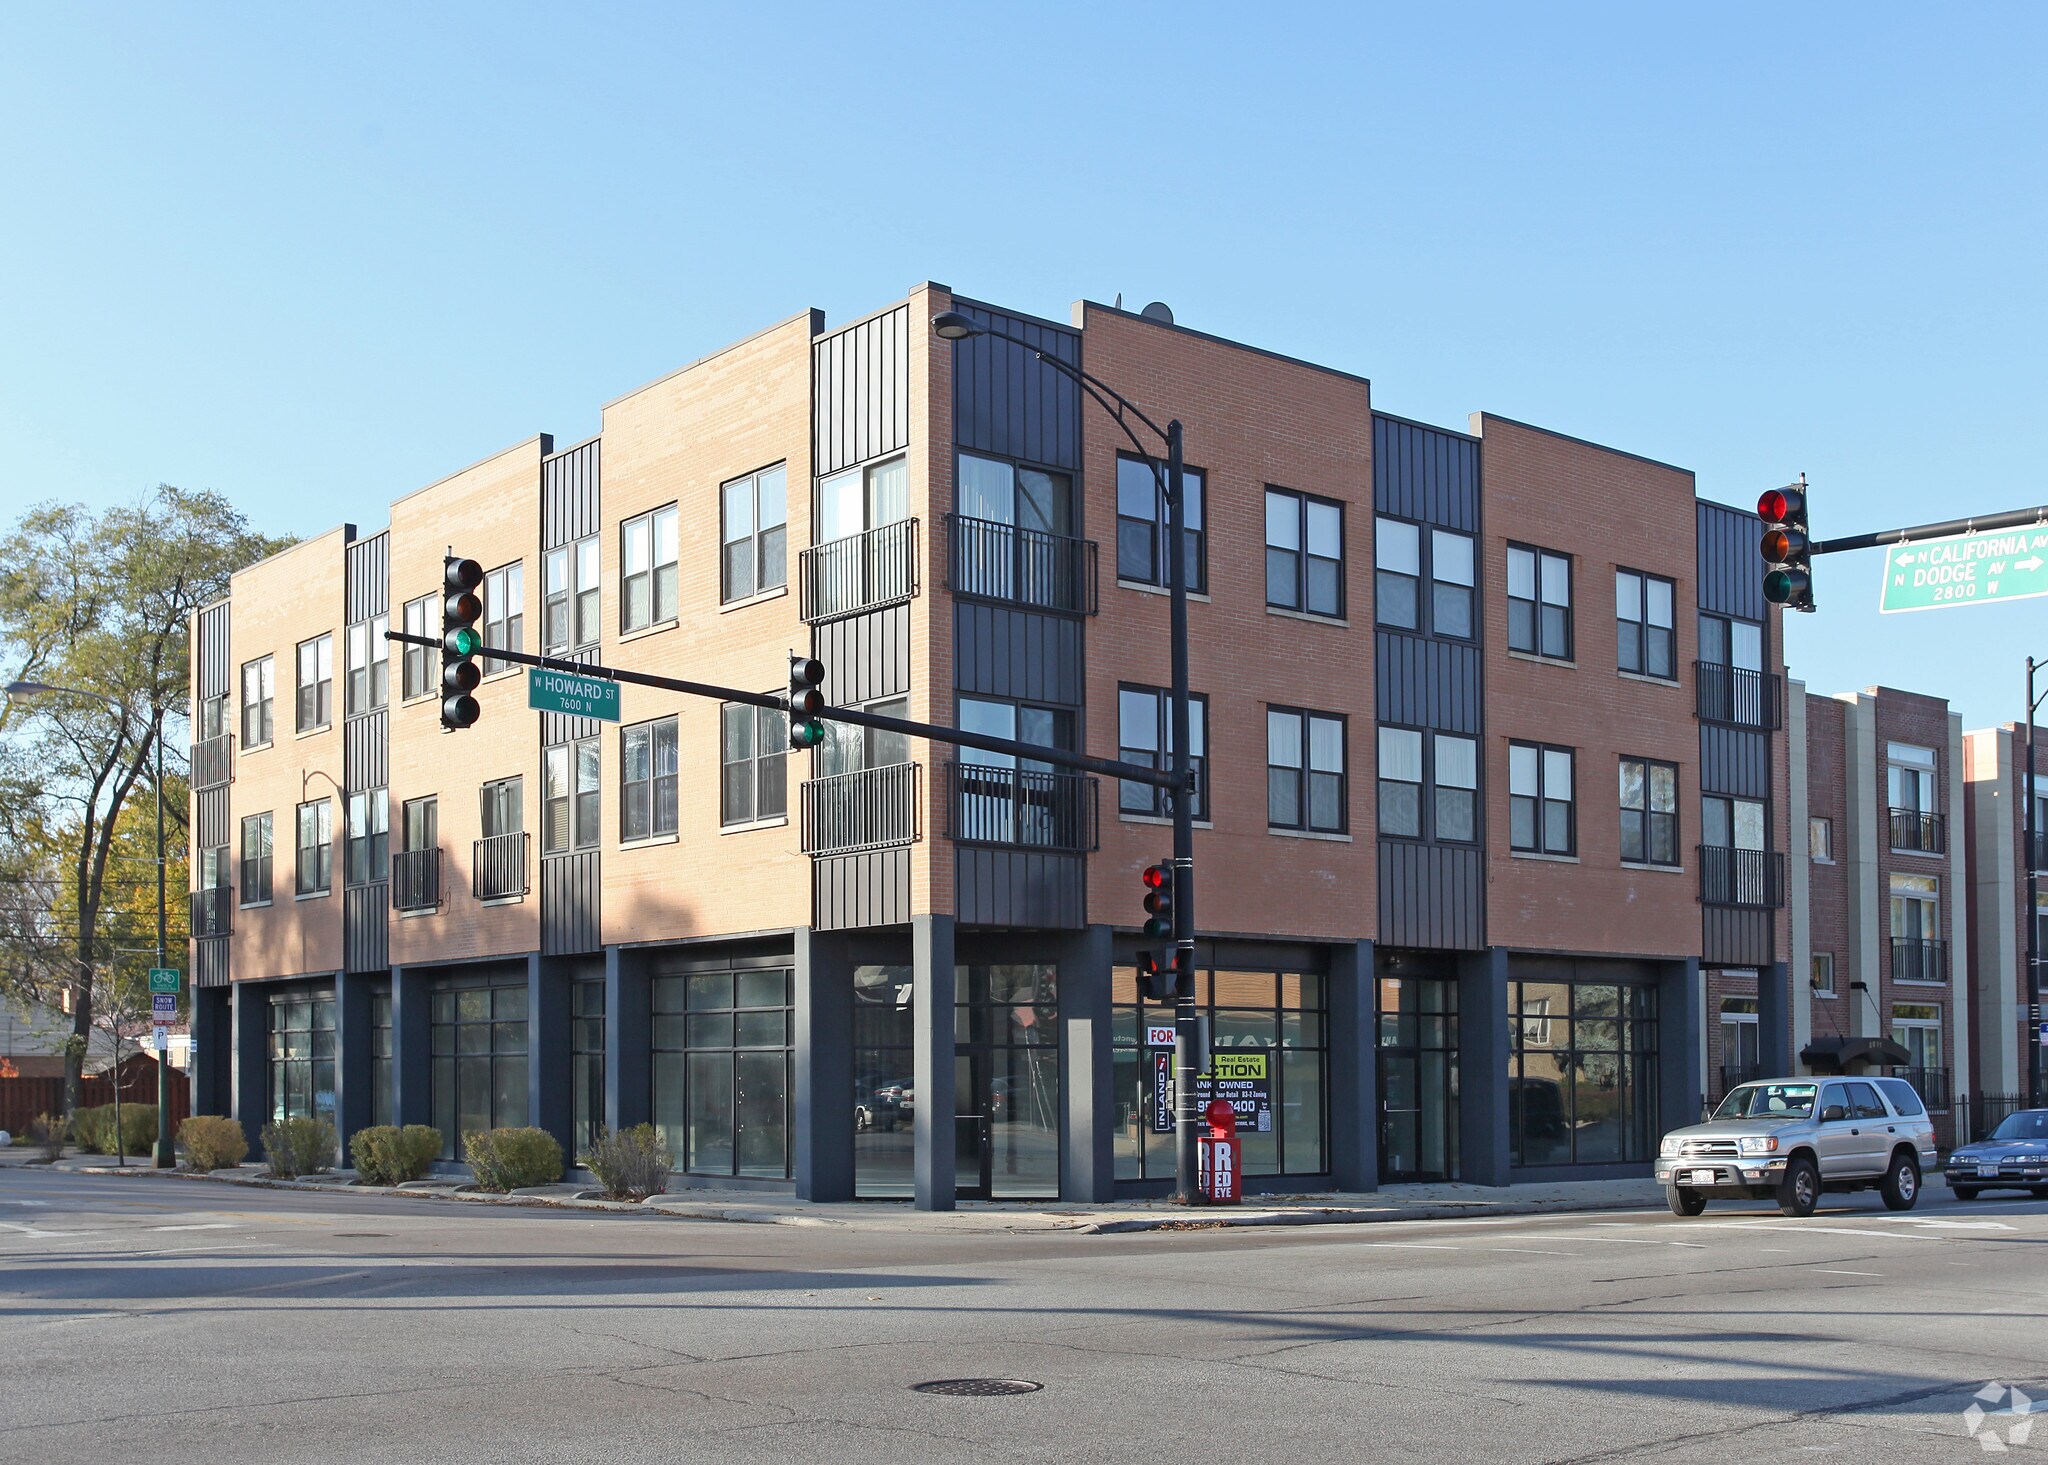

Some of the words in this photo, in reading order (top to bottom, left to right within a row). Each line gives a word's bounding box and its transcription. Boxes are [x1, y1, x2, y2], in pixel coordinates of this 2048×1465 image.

[1917, 551, 1928, 564] N
[1929, 534, 2028, 566] CALIFORNIA
[2030, 535, 2048, 550] AV
[1894, 573, 1905, 587] N
[1913, 561, 1977, 588] DODGE
[1986, 561, 2007, 576] AV
[1932, 583, 1976, 601] 2800
[1987, 580, 1999, 595] W
[534, 676, 542, 688] W
[545, 675, 602, 700] HOWARD
[605, 688, 615, 700] ST
[559, 696, 581, 711] 7600
[585, 702, 592, 713] N
[154, 1003, 174, 1011] ROUTE
[1151, 1029, 1174, 1043] FOR
[1218, 1081, 1254, 1089] OWNED
[1197, 1090, 1211, 1098] round
[1214, 1142, 1232, 1171] R
[1214, 1171, 1232, 1187] ED
[1214, 1187, 1232, 1198] EYE
